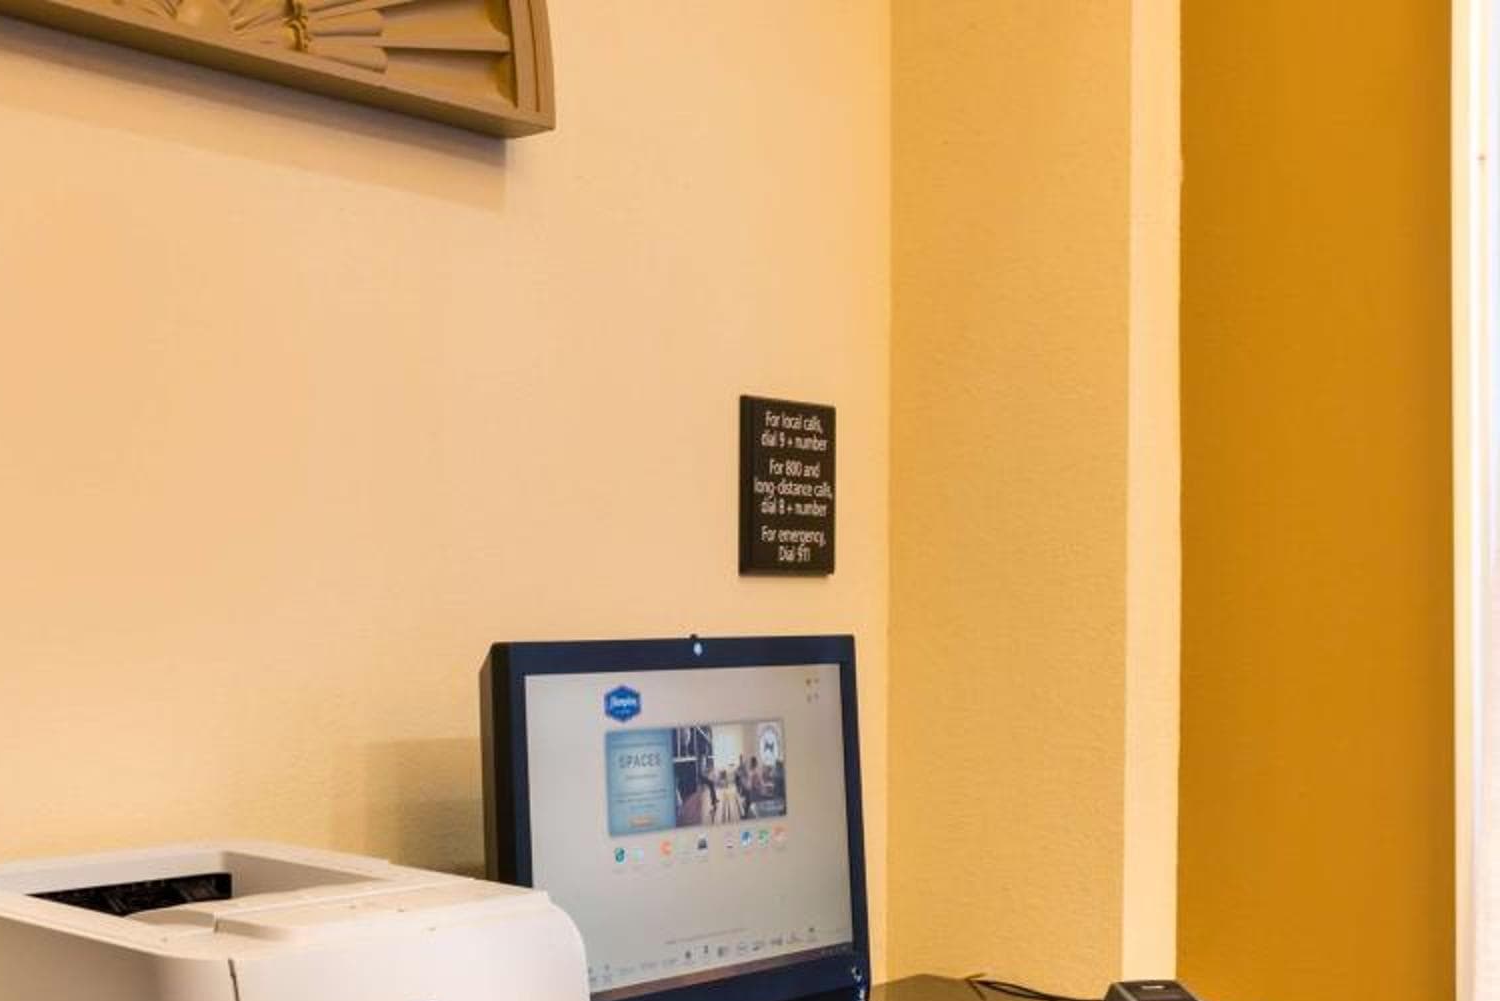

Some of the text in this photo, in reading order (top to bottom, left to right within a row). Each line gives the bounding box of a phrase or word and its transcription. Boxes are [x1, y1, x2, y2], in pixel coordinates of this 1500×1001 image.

[765, 410, 780, 428] For
[781, 411, 802, 430] local
[761, 430, 777, 447] dial
[795, 434, 828, 451] number
[769, 458, 820, 478] For 800 and
[754, 477, 812, 499] long-distance
[761, 497, 776, 514] dial
[795, 500, 827, 517] number
[761, 525, 777, 542] For
[779, 545, 795, 562] Dial
